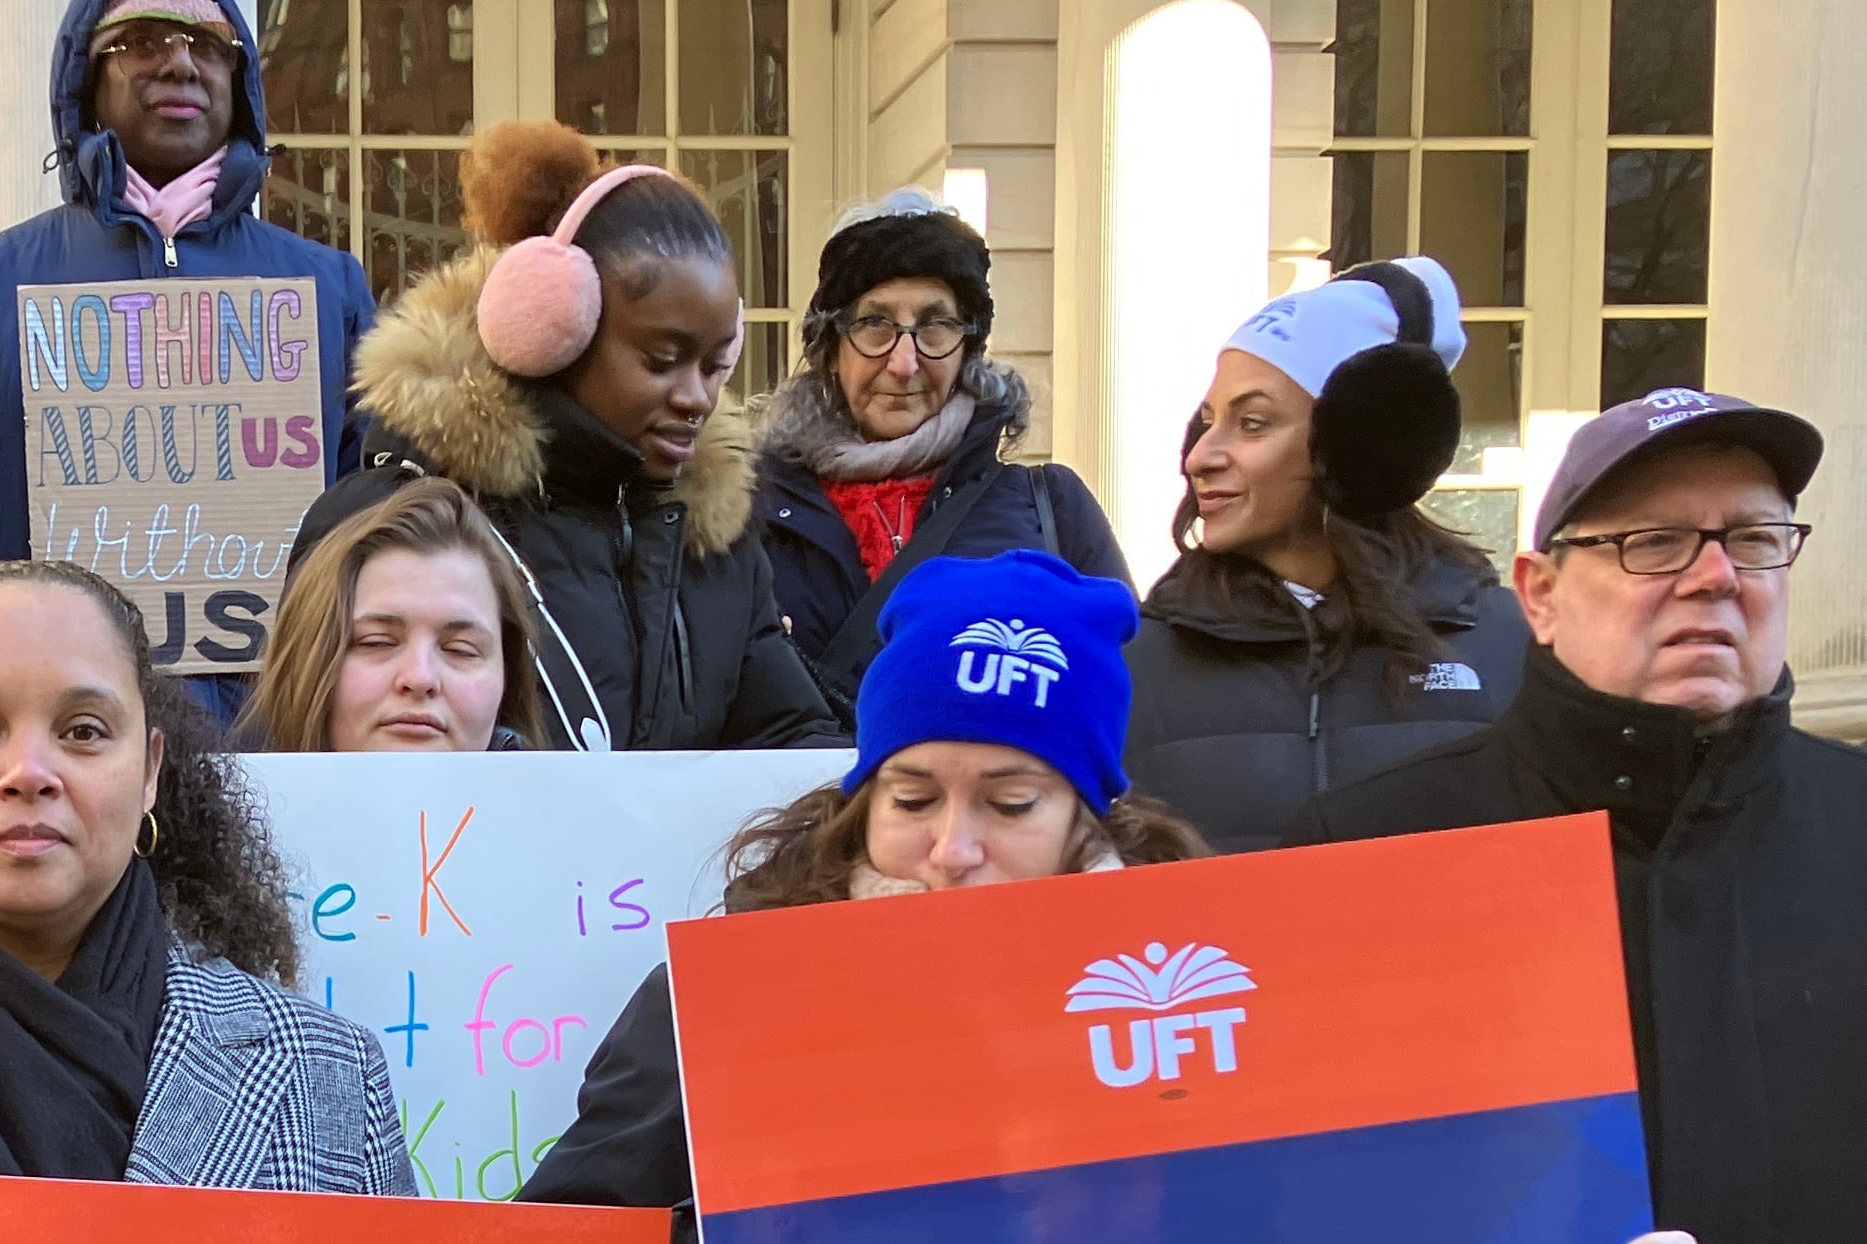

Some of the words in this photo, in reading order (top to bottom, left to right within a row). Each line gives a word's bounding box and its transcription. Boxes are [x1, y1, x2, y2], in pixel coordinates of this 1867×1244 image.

[24, 288, 308, 393] NOTHING
[37, 403, 243, 488] ABOUT
[241, 415, 322, 470] US
[956, 650, 1061, 709] UFT
[1423, 681, 1457, 692] FACE
[576, 877, 651, 937] is
[1088, 1007, 1246, 1088] UFT
